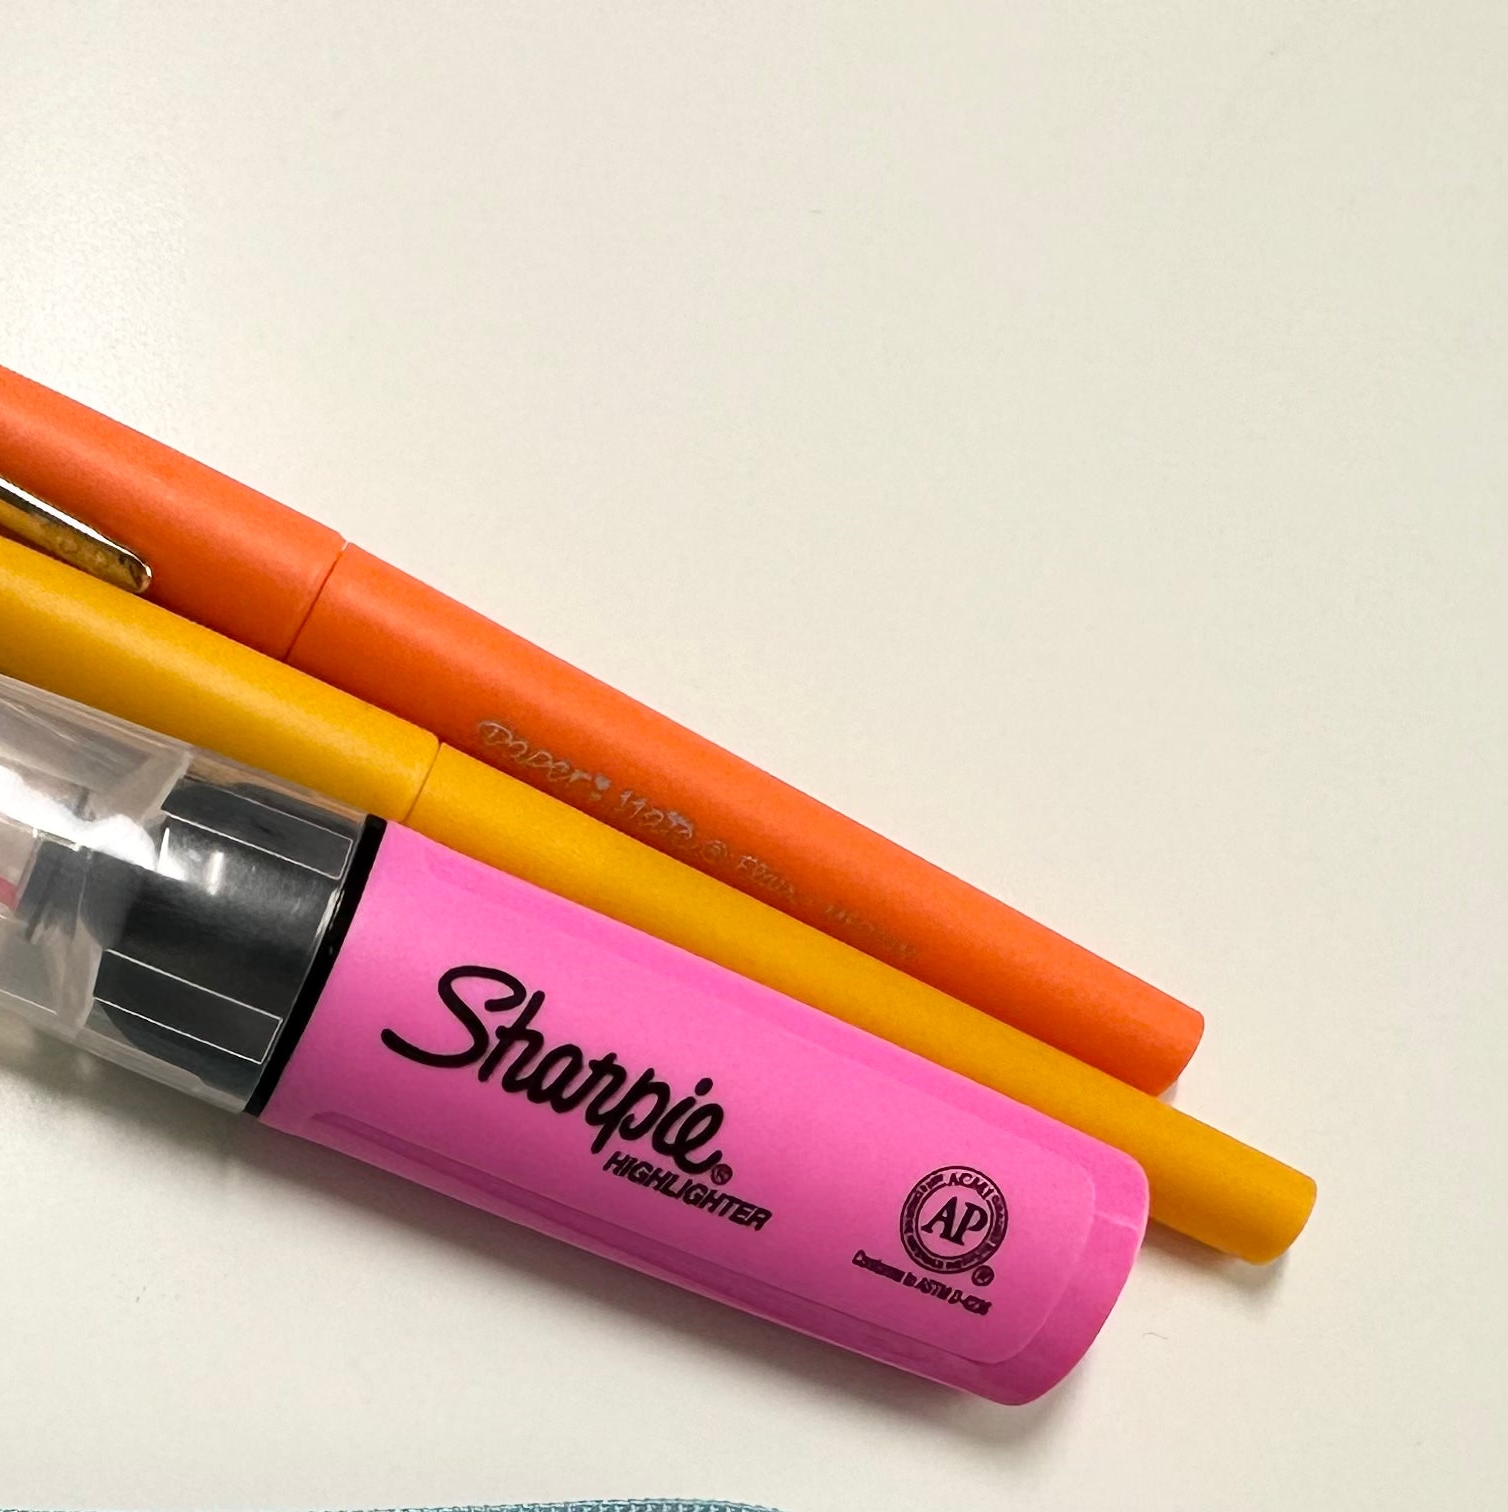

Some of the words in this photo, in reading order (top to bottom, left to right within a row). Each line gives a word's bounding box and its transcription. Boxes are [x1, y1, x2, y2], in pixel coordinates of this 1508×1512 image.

[380, 965, 725, 1175] Sharpie
[602, 1150, 773, 1232] HIGHLIGHTER
[921, 1196, 989, 1246] AP
